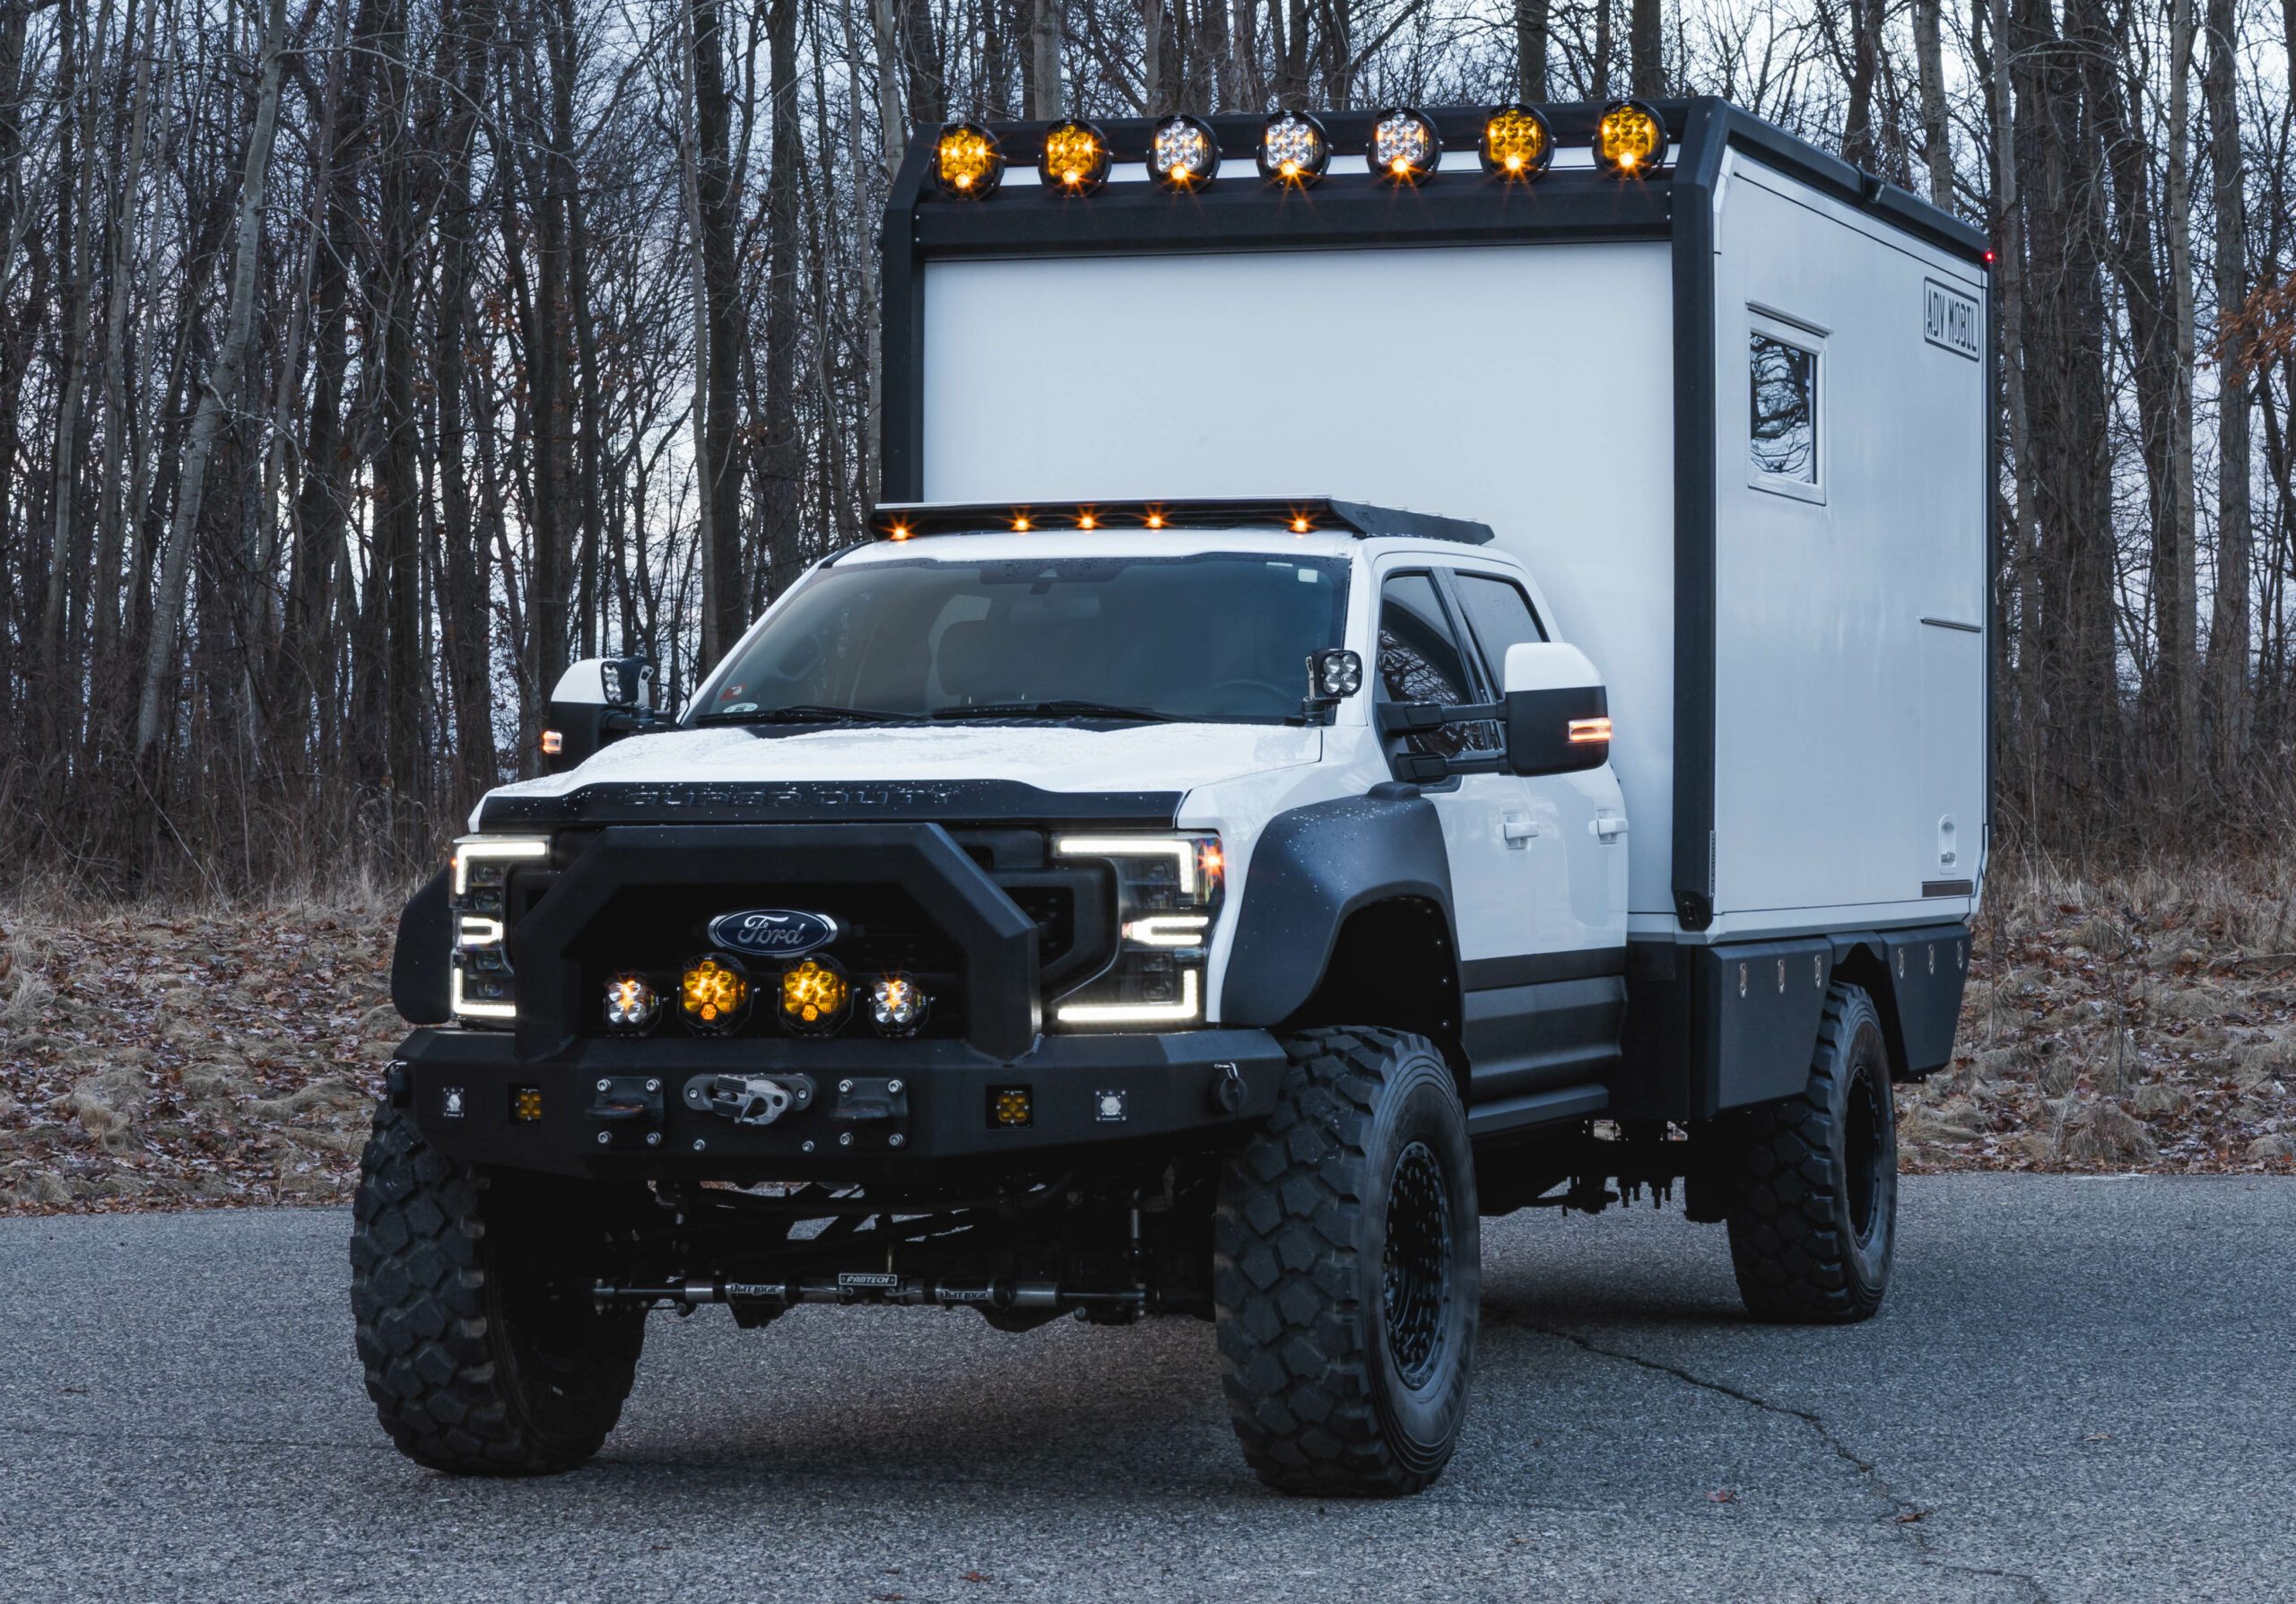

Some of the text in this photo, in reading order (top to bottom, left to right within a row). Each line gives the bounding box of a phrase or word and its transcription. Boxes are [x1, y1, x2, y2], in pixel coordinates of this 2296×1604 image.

[1926, 289, 1978, 352] ADV MOBIL
[624, 789, 958, 807] SUPER DUTY
[737, 914, 806, 945] Ford
[846, 1276, 891, 1284] FABTECH
